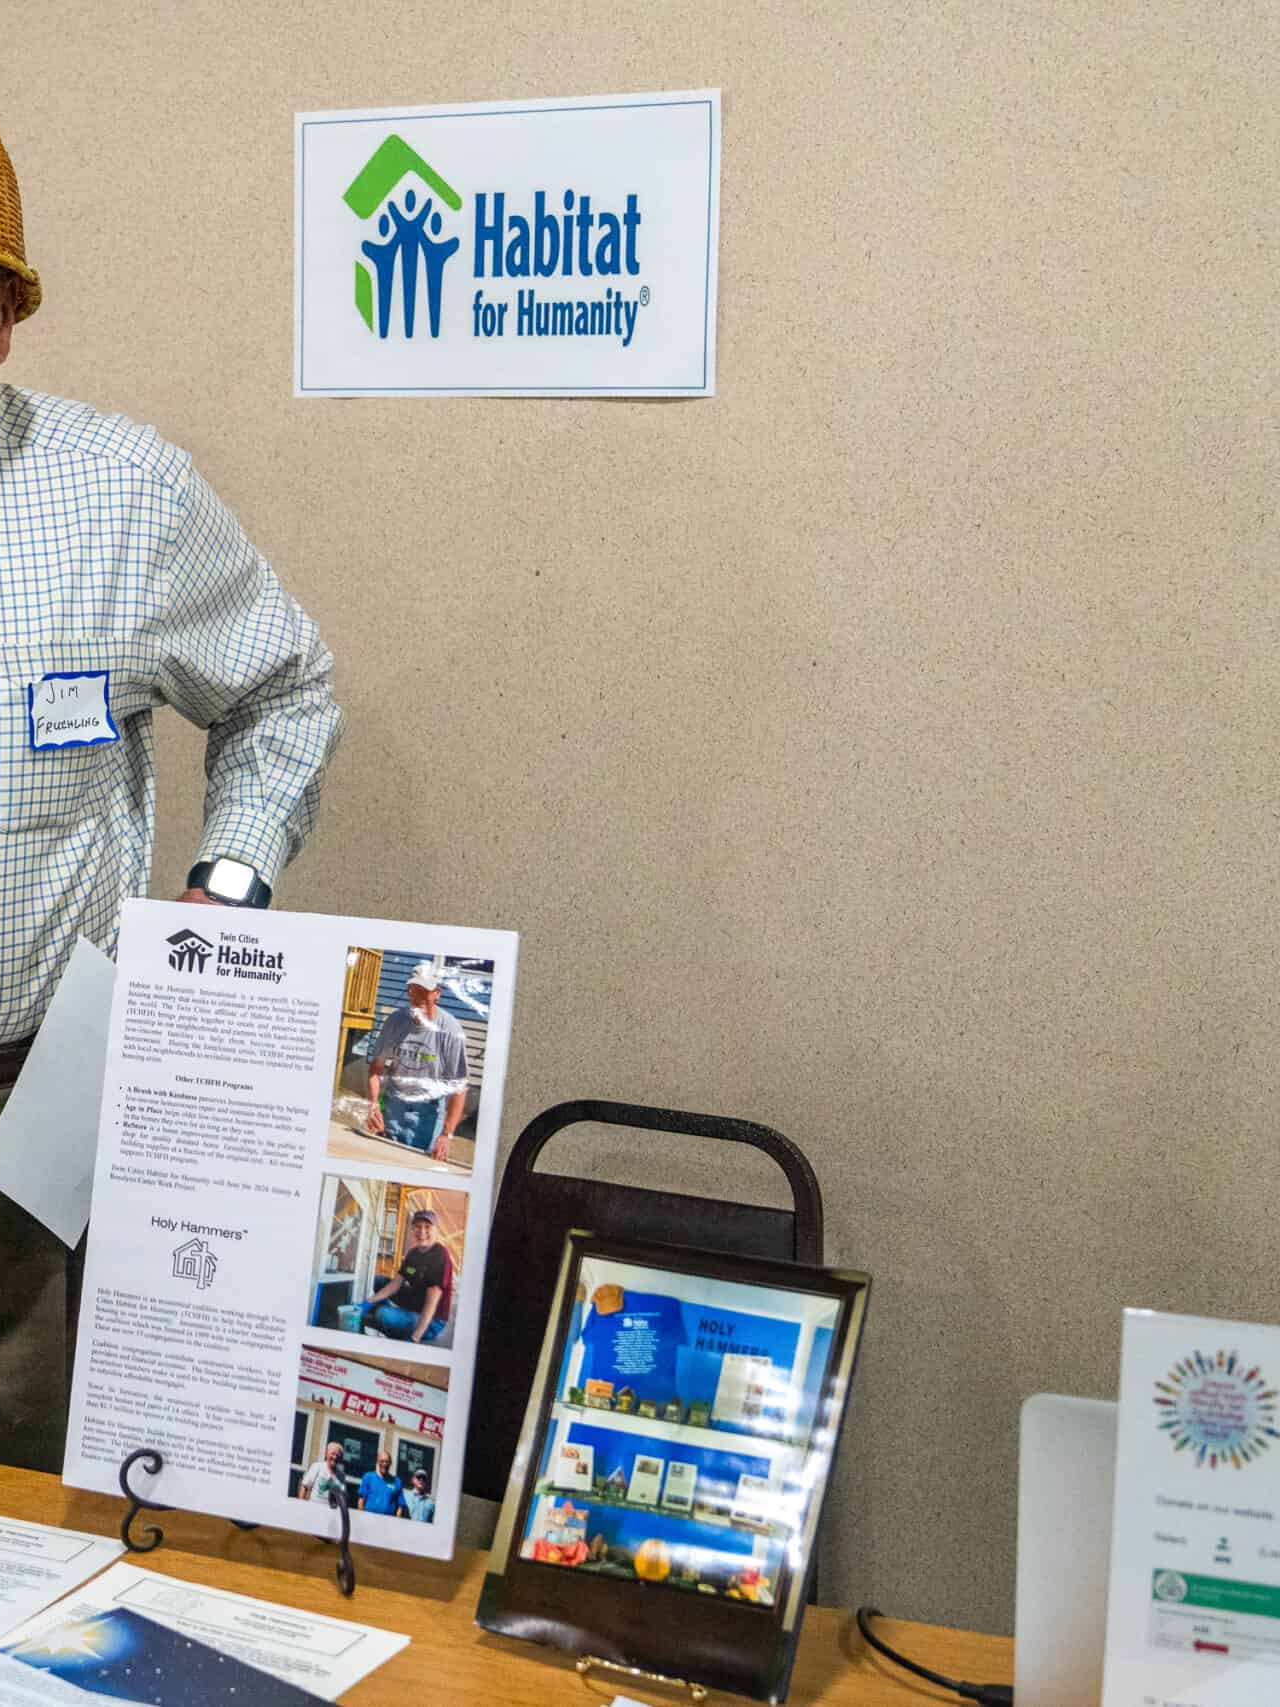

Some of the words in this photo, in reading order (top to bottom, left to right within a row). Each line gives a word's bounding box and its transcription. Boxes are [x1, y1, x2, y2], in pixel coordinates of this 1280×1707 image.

[473, 189, 641, 278] Habitat
[473, 288, 507, 337] for
[46, 681, 79, 704] JIM
[220, 932, 236, 943] Twin
[238, 934, 259, 945] Cities
[217, 945, 284, 970] Habitat
[216, 965, 231, 977] for
[151, 1215, 178, 1232] Holy
[698, 1319, 735, 1336] HOLY
